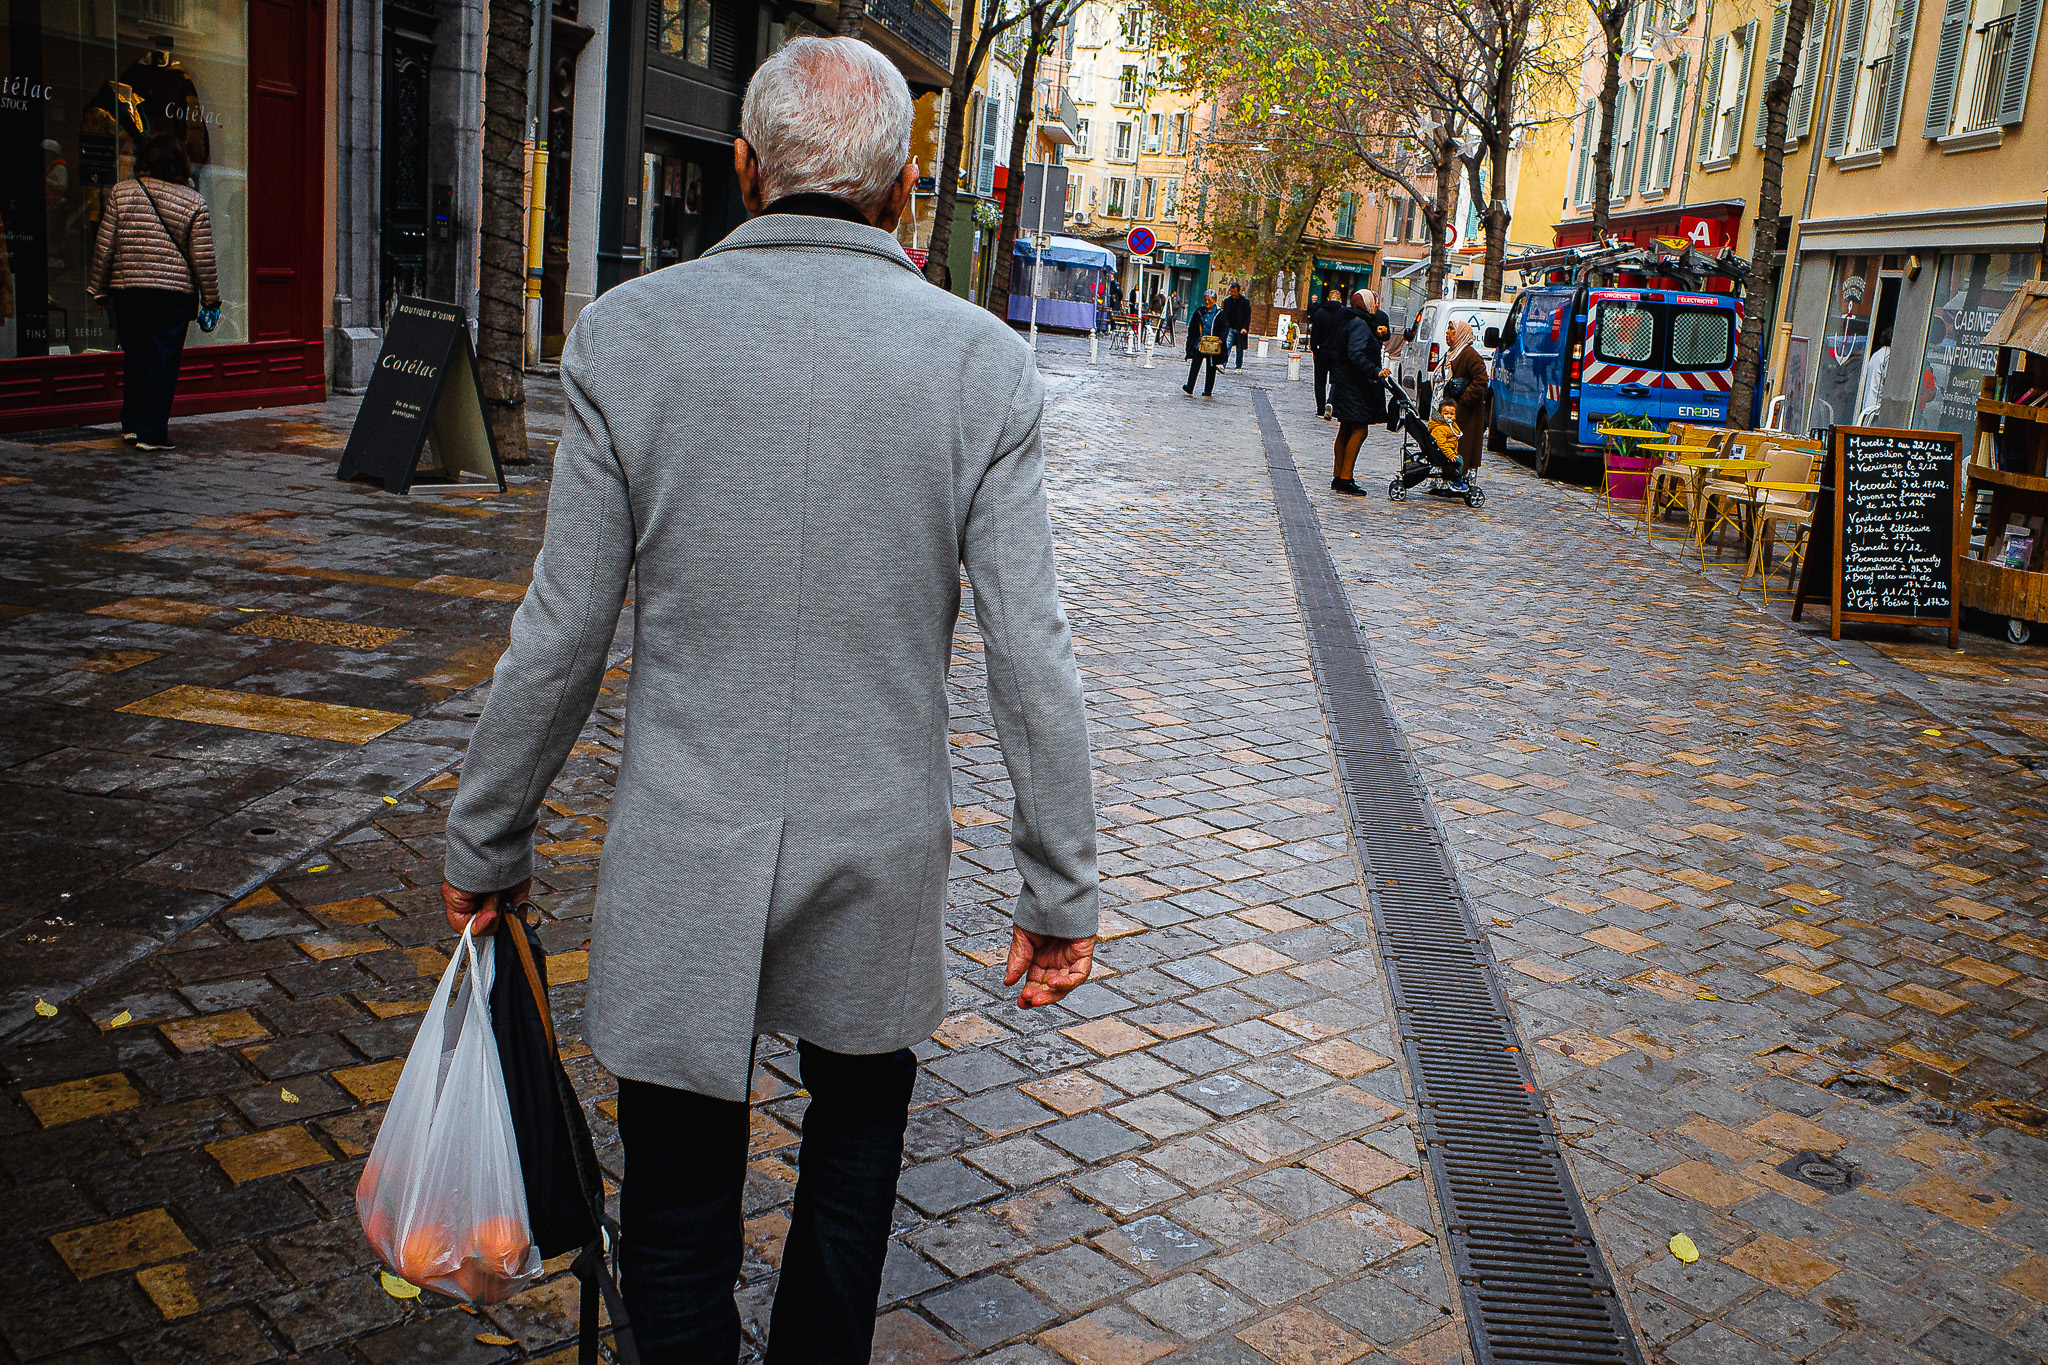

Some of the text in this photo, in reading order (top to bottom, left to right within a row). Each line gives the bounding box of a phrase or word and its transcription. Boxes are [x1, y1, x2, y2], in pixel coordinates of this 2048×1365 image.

[0, 97, 28, 111] STOCK
[165, 102, 222, 125] Cotélac
[1603, 292, 1632, 300] URGENCE
[400, 304, 456, 322] BOUTIQUE D'USINE
[1954, 310, 2000, 333] CABINET
[26, 329, 47, 339] FINS
[55, 328, 66, 338] DE
[1961, 334, 1970, 345] DE
[1943, 345, 1999, 370] INFIRMIERS
[382, 354, 437, 378] Cotélac
[1849, 437, 1885, 448] Mardi
[1886, 438, 1894, 448] 2
[1897, 441, 1911, 449] au
[1856, 448, 1904, 462] Exposition
[1856, 460, 1938, 473] Vernissage le 2/12
[1881, 470, 1890, 478] à
[1849, 479, 1897, 491] Mercredi
[1901, 479, 1908, 489] 3
[1910, 480, 1920, 489] et
[1898, 489, 1937, 502] français
[1866, 501, 1877, 509] de
[1848, 511, 1893, 524] Vendredi
[1889, 523, 1931, 533] littéraire
[1880, 533, 1914, 542] à 17h
[1850, 542, 1889, 553] Samedi
[1851, 552, 1942, 568] Permanence Amnesty
[1845, 563, 1897, 573] International
[1900, 564, 1907, 572] à
[1876, 571, 1897, 580] entre
[1919, 574, 1932, 582] de
[1903, 581, 1922, 589] 17h
[1923, 581, 1930, 589] à
[1847, 586, 1877, 601] Jeudi
[1857, 596, 1950, 611] Café Poésie à 17h30
